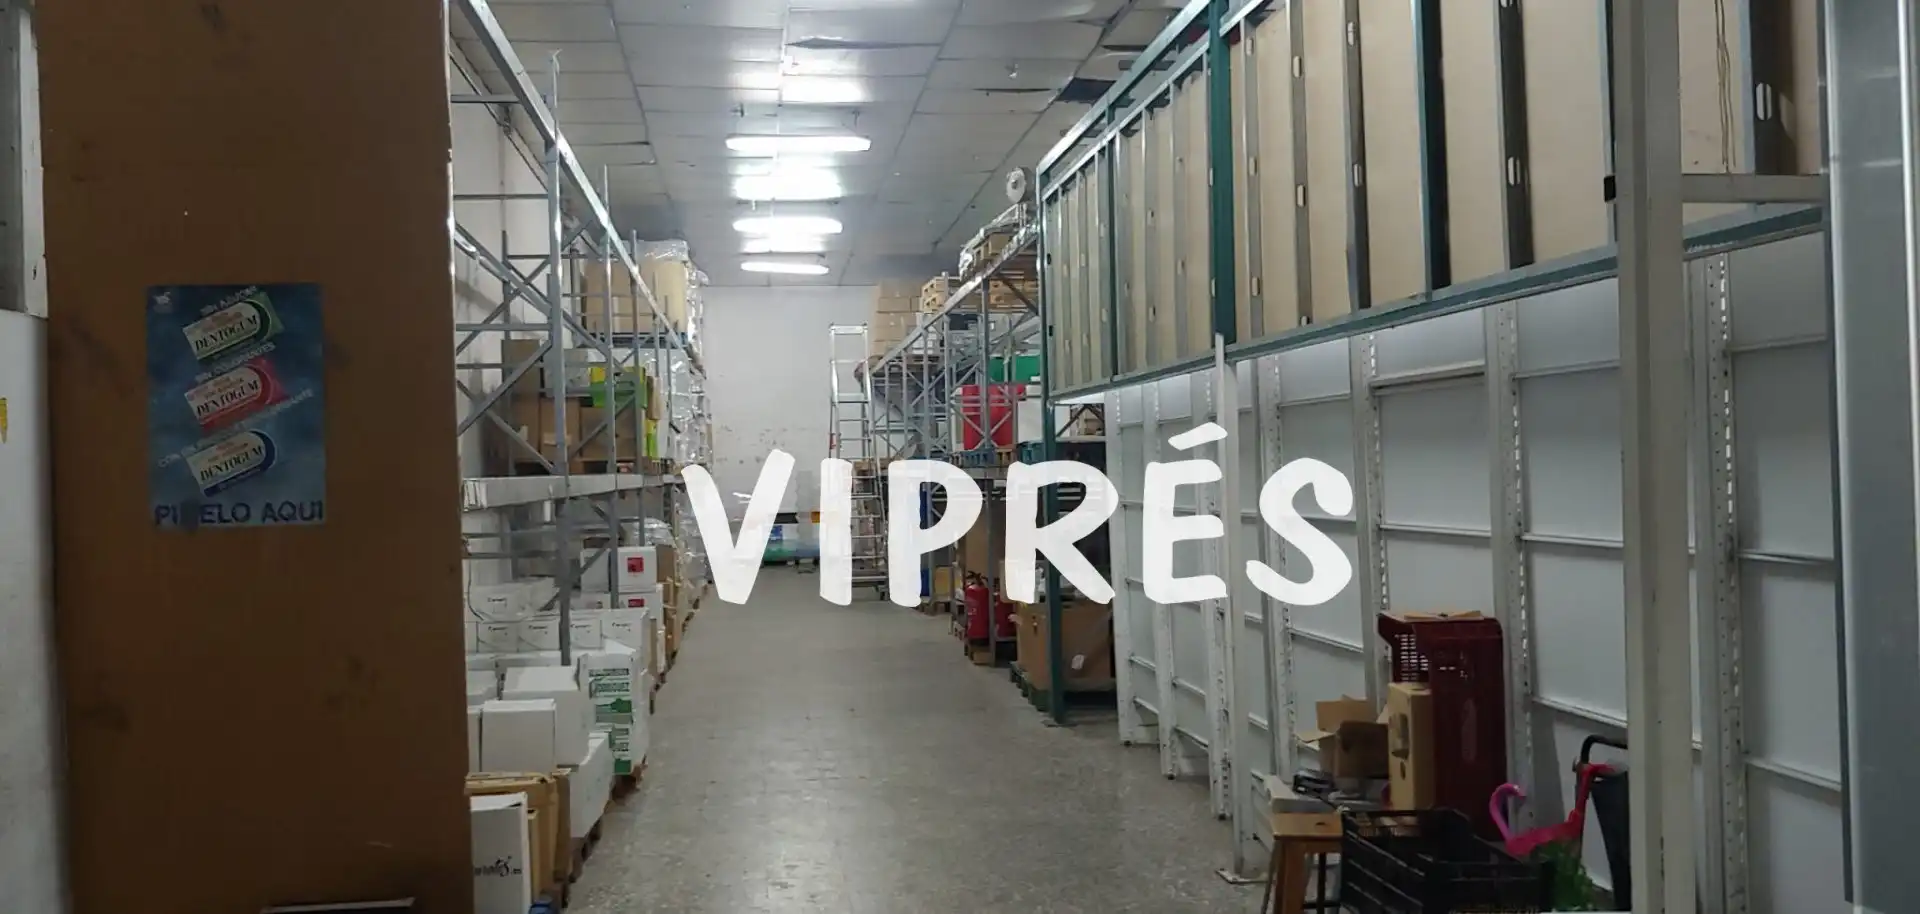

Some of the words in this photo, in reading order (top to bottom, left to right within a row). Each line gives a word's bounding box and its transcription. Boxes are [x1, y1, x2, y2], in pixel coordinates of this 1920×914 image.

[194, 313, 258, 351] DENTOGUM
[196, 380, 259, 417] DENTOGUM
[199, 446, 263, 482] DENTOGUM
[154, 502, 251, 526] PIELO
